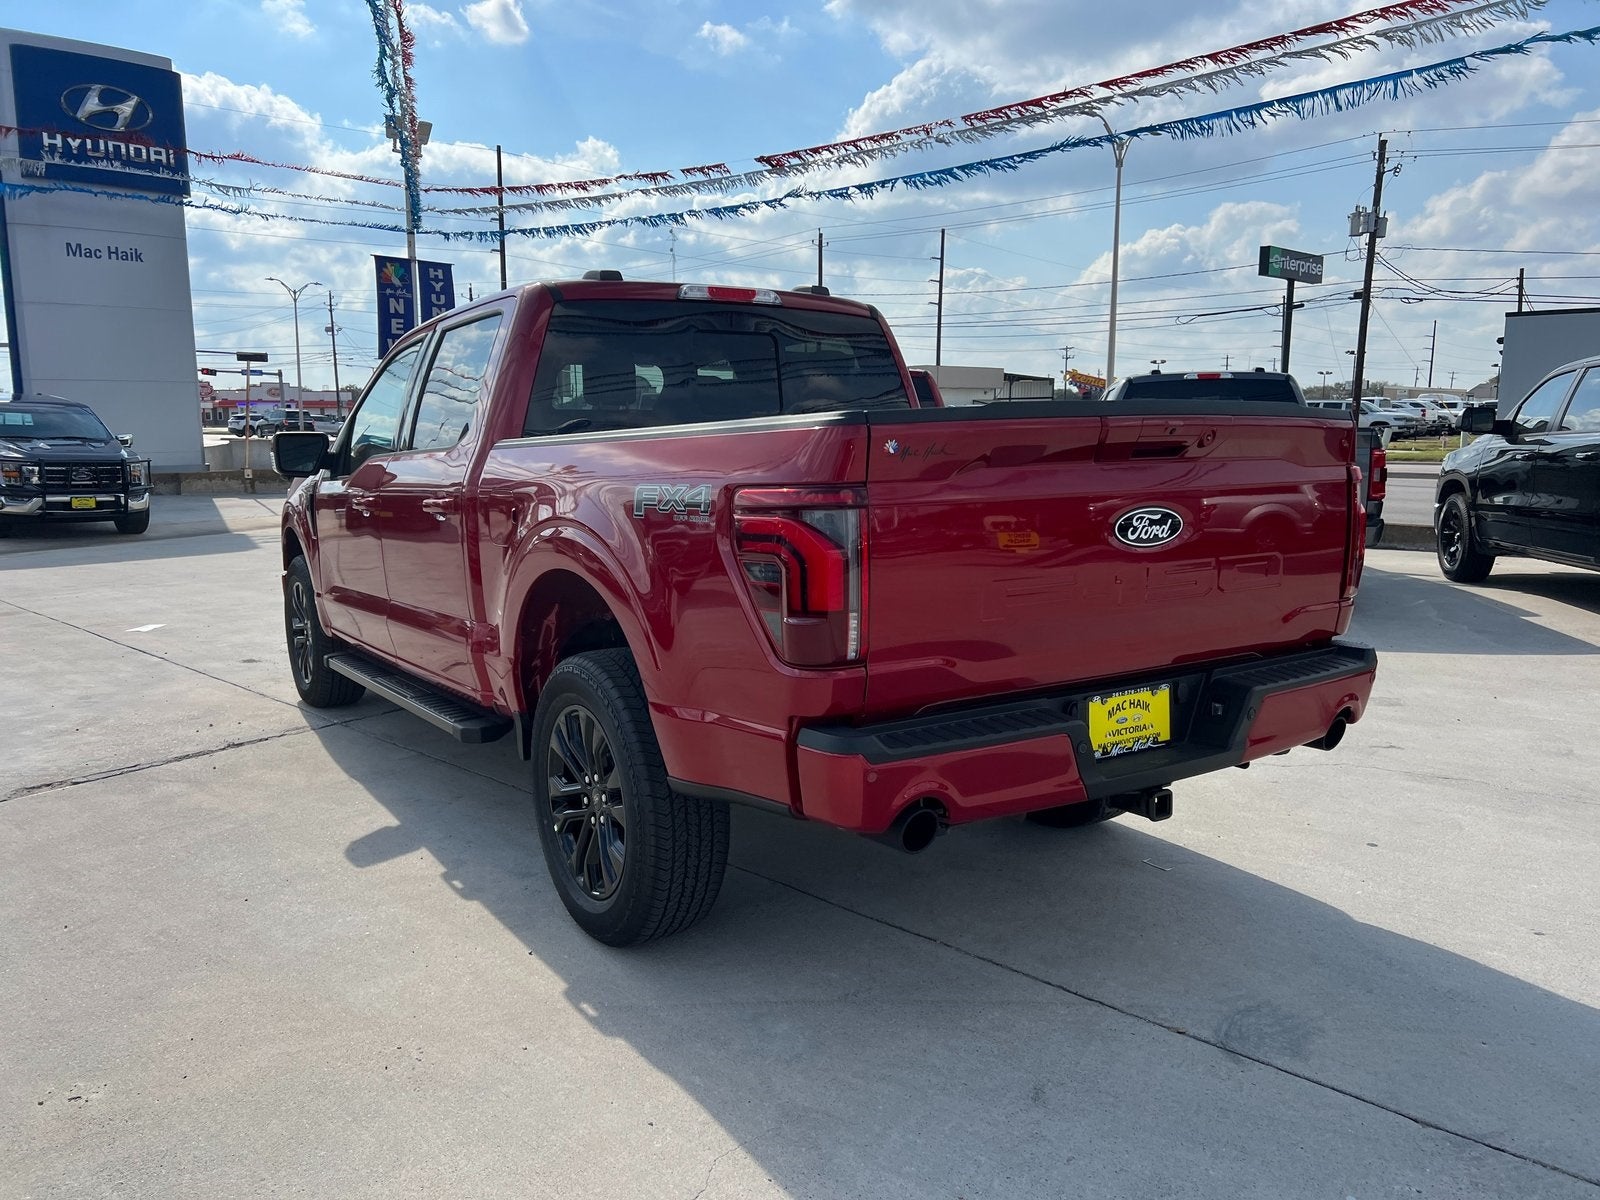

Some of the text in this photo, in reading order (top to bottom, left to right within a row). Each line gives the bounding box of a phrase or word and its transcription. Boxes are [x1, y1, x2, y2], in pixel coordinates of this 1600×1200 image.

[42, 131, 175, 168] HYUNDAI
[66, 242, 144, 262] Mac Haik
[1270, 254, 1323, 276] enterprise
[1063, 368, 1107, 387] Premie
[633, 484, 712, 518] FX4
[1128, 514, 1172, 540] Ford
[1107, 699, 1151, 720] MAC HAIK
[1111, 723, 1148, 737] VICTORIA
[1110, 738, 1166, 756] Mac Haik
